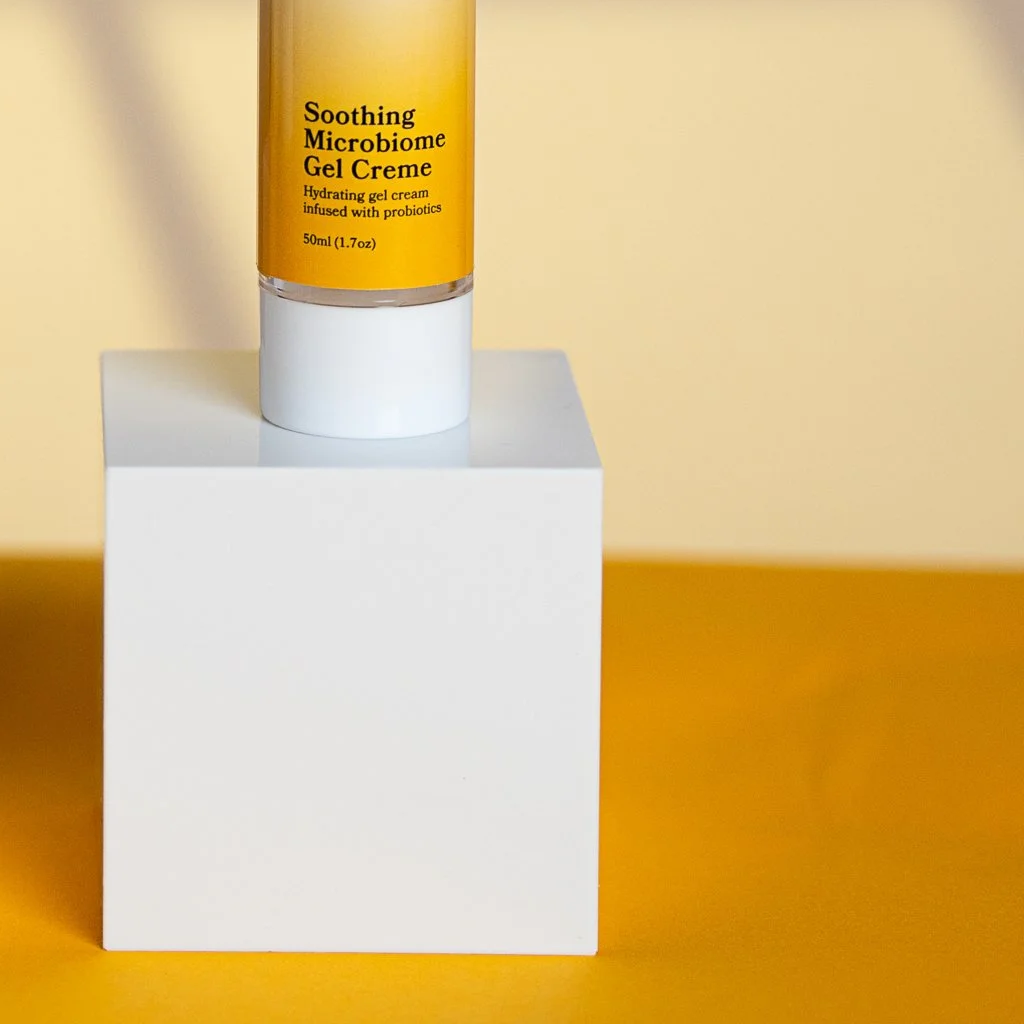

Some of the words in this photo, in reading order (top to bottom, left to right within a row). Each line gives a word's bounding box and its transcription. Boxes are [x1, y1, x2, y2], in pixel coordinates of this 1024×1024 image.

[304, 101, 417, 130] Soothing
[304, 128, 446, 154] Microbiome
[303, 155, 344, 179] Gel
[351, 159, 432, 180] Creme
[303, 185, 366, 204] Hydrating
[369, 189, 388, 204] gel
[391, 190, 429, 201] cream
[303, 202, 348, 217] infused
[351, 206, 380, 218] with
[384, 203, 442, 220] probiotics
[303, 233, 332, 247] 50ml
[334, 236, 377, 252] (1.7oz)
